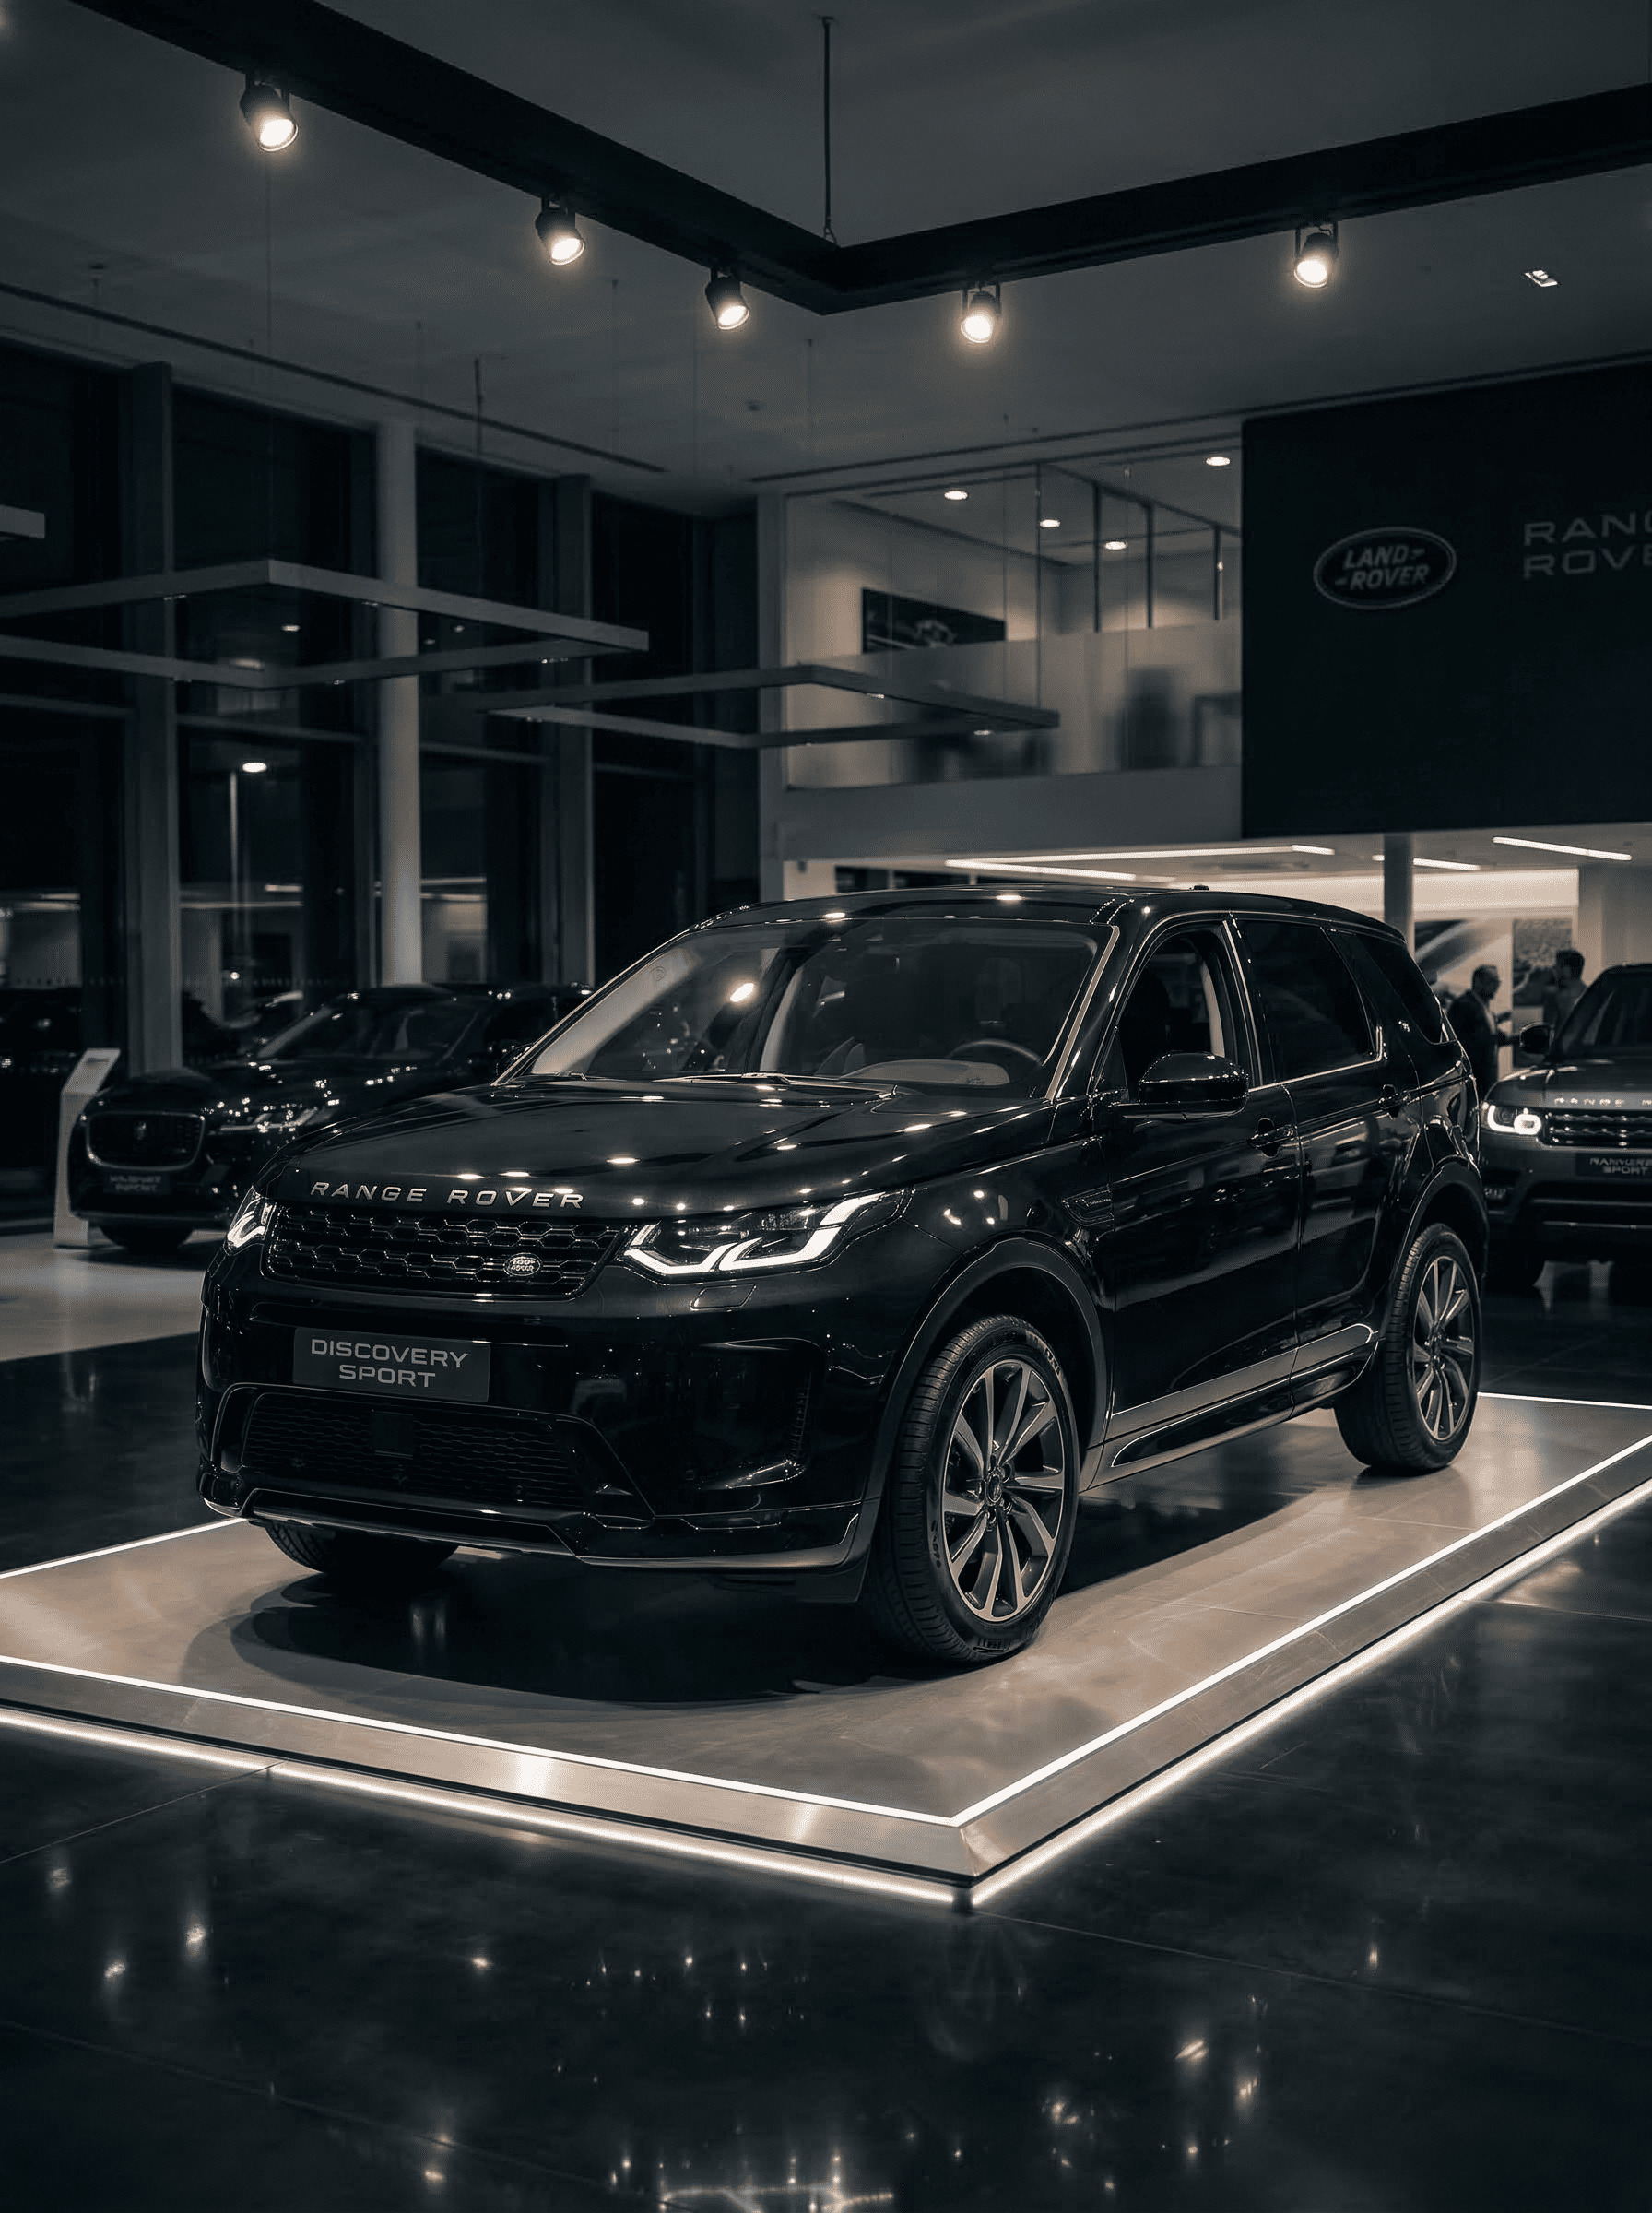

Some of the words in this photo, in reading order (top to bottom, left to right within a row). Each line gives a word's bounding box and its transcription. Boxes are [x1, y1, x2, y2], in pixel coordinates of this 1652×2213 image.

[1524, 510, 1652, 546] RAN
[310, 1181, 428, 1202] RANGE
[446, 1189, 584, 1209] ROVER
[311, 1339, 469, 1368] DISCOVERY
[339, 1365, 436, 1388] SPORT
